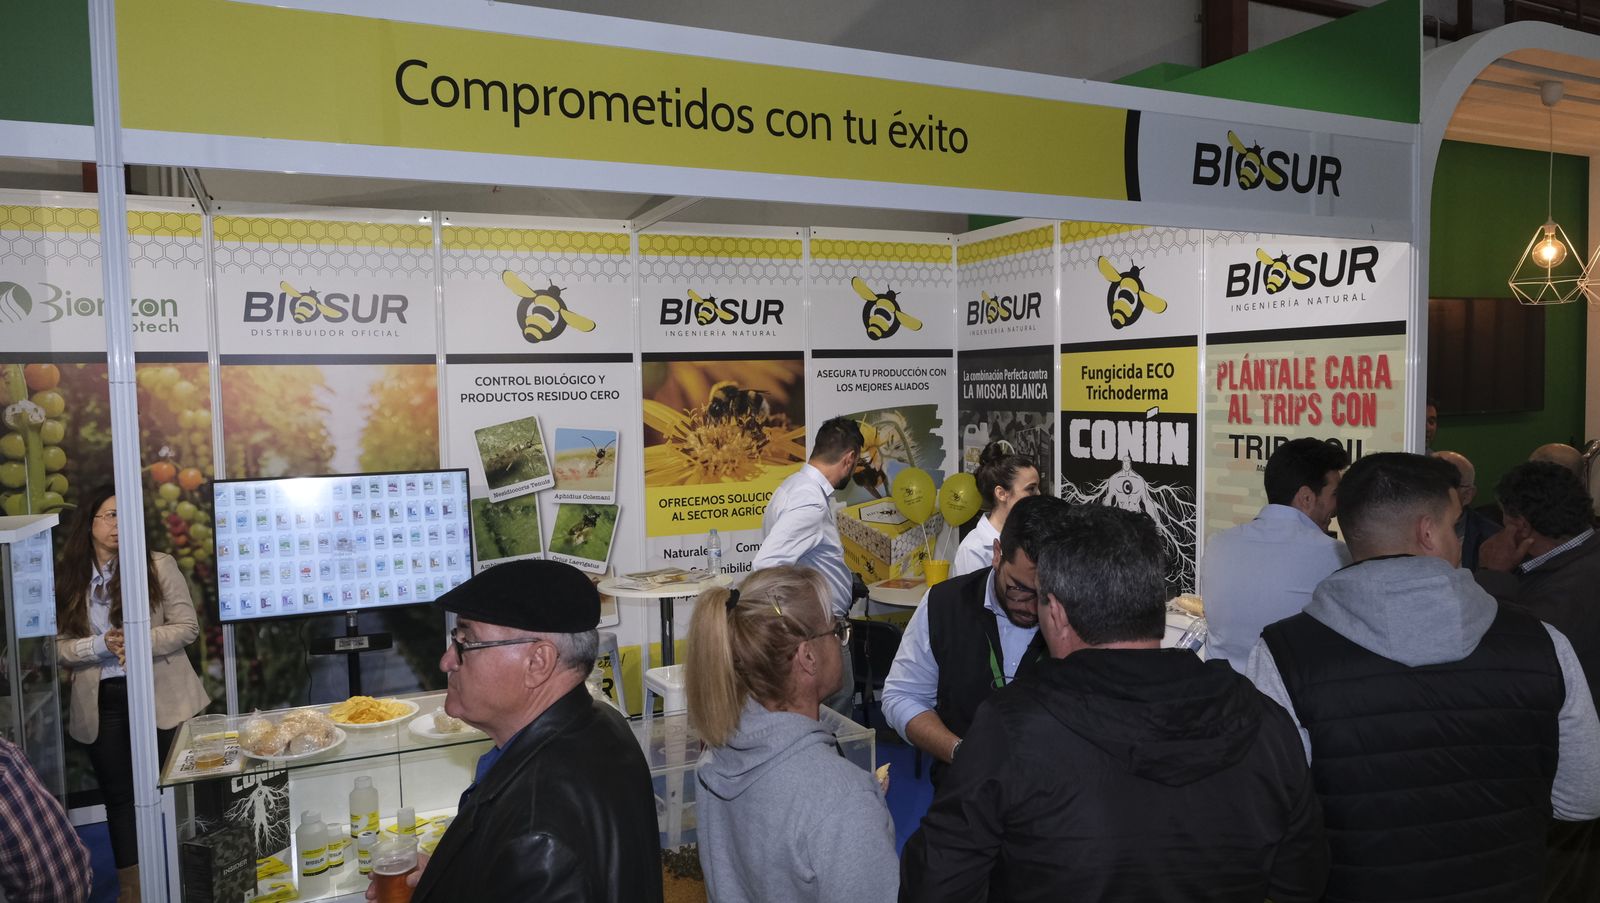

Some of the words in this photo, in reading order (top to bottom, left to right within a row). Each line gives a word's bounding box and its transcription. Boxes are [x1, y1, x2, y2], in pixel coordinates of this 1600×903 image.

[395, 59, 755, 134] Comprometidos
[766, 106, 832, 142] con
[843, 109, 878, 145] tu
[888, 111, 969, 154] éxito
[1192, 138, 1342, 197] BIOSUR
[1226, 246, 1379, 297] BIOSUR
[243, 288, 409, 324] BIOSUR
[660, 296, 784, 326] BIOSUR
[967, 292, 1042, 326] BIOSUR
[1231, 300, 1299, 312] INGENIERÍA
[1307, 293, 1367, 305] NATURAL
[251, 329, 345, 337] DISTRIBUIDOR
[969, 327, 1004, 336] INGENIERÍA
[1007, 325, 1037, 333] NATURAL
[475, 376, 532, 387] CONTROL
[534, 373, 596, 386] BIOLÓGICO
[598, 375, 606, 385] Y
[816, 369, 857, 378] ASEGURA
[859, 369, 871, 377] TU
[872, 366, 928, 377] PRODUCCIÓN
[929, 368, 947, 376] CON
[963, 370, 970, 381] La
[970, 368, 1003, 381] combinación
[1004, 368, 1028, 380] Perfecta
[1028, 368, 1048, 380] contra
[1081, 363, 1143, 383] Fungicida
[1146, 362, 1175, 379] ECO
[1217, 353, 1316, 390] PLÁNTALE
[1325, 354, 1392, 390] CARA
[836, 383, 854, 392] LOS
[855, 382, 893, 393] MEJORES
[894, 382, 930, 391] ALIADOS
[963, 384, 974, 399] LA
[976, 383, 1008, 399] MOSCA
[1010, 382, 1048, 399] BLANCA
[1086, 384, 1169, 401] Trichoderma
[460, 391, 534, 403] PRODUCTOS
[537, 391, 588, 401] RESIDUO
[590, 390, 620, 400] CERO
[1228, 393, 1253, 425] AL
[1261, 392, 1322, 426] TRIPS
[1331, 392, 1377, 427] CON
[1069, 406, 1189, 466] CONÍN
[554, 493, 582, 501] Aphidius
[658, 495, 725, 508] OFRECEMOS
[727, 491, 773, 504] SOLUCIO
[672, 512, 685, 522] AL
[687, 509, 729, 520] SECTOR
[663, 546, 709, 559] Naturale
[223, 859, 248, 876] INSIDER
